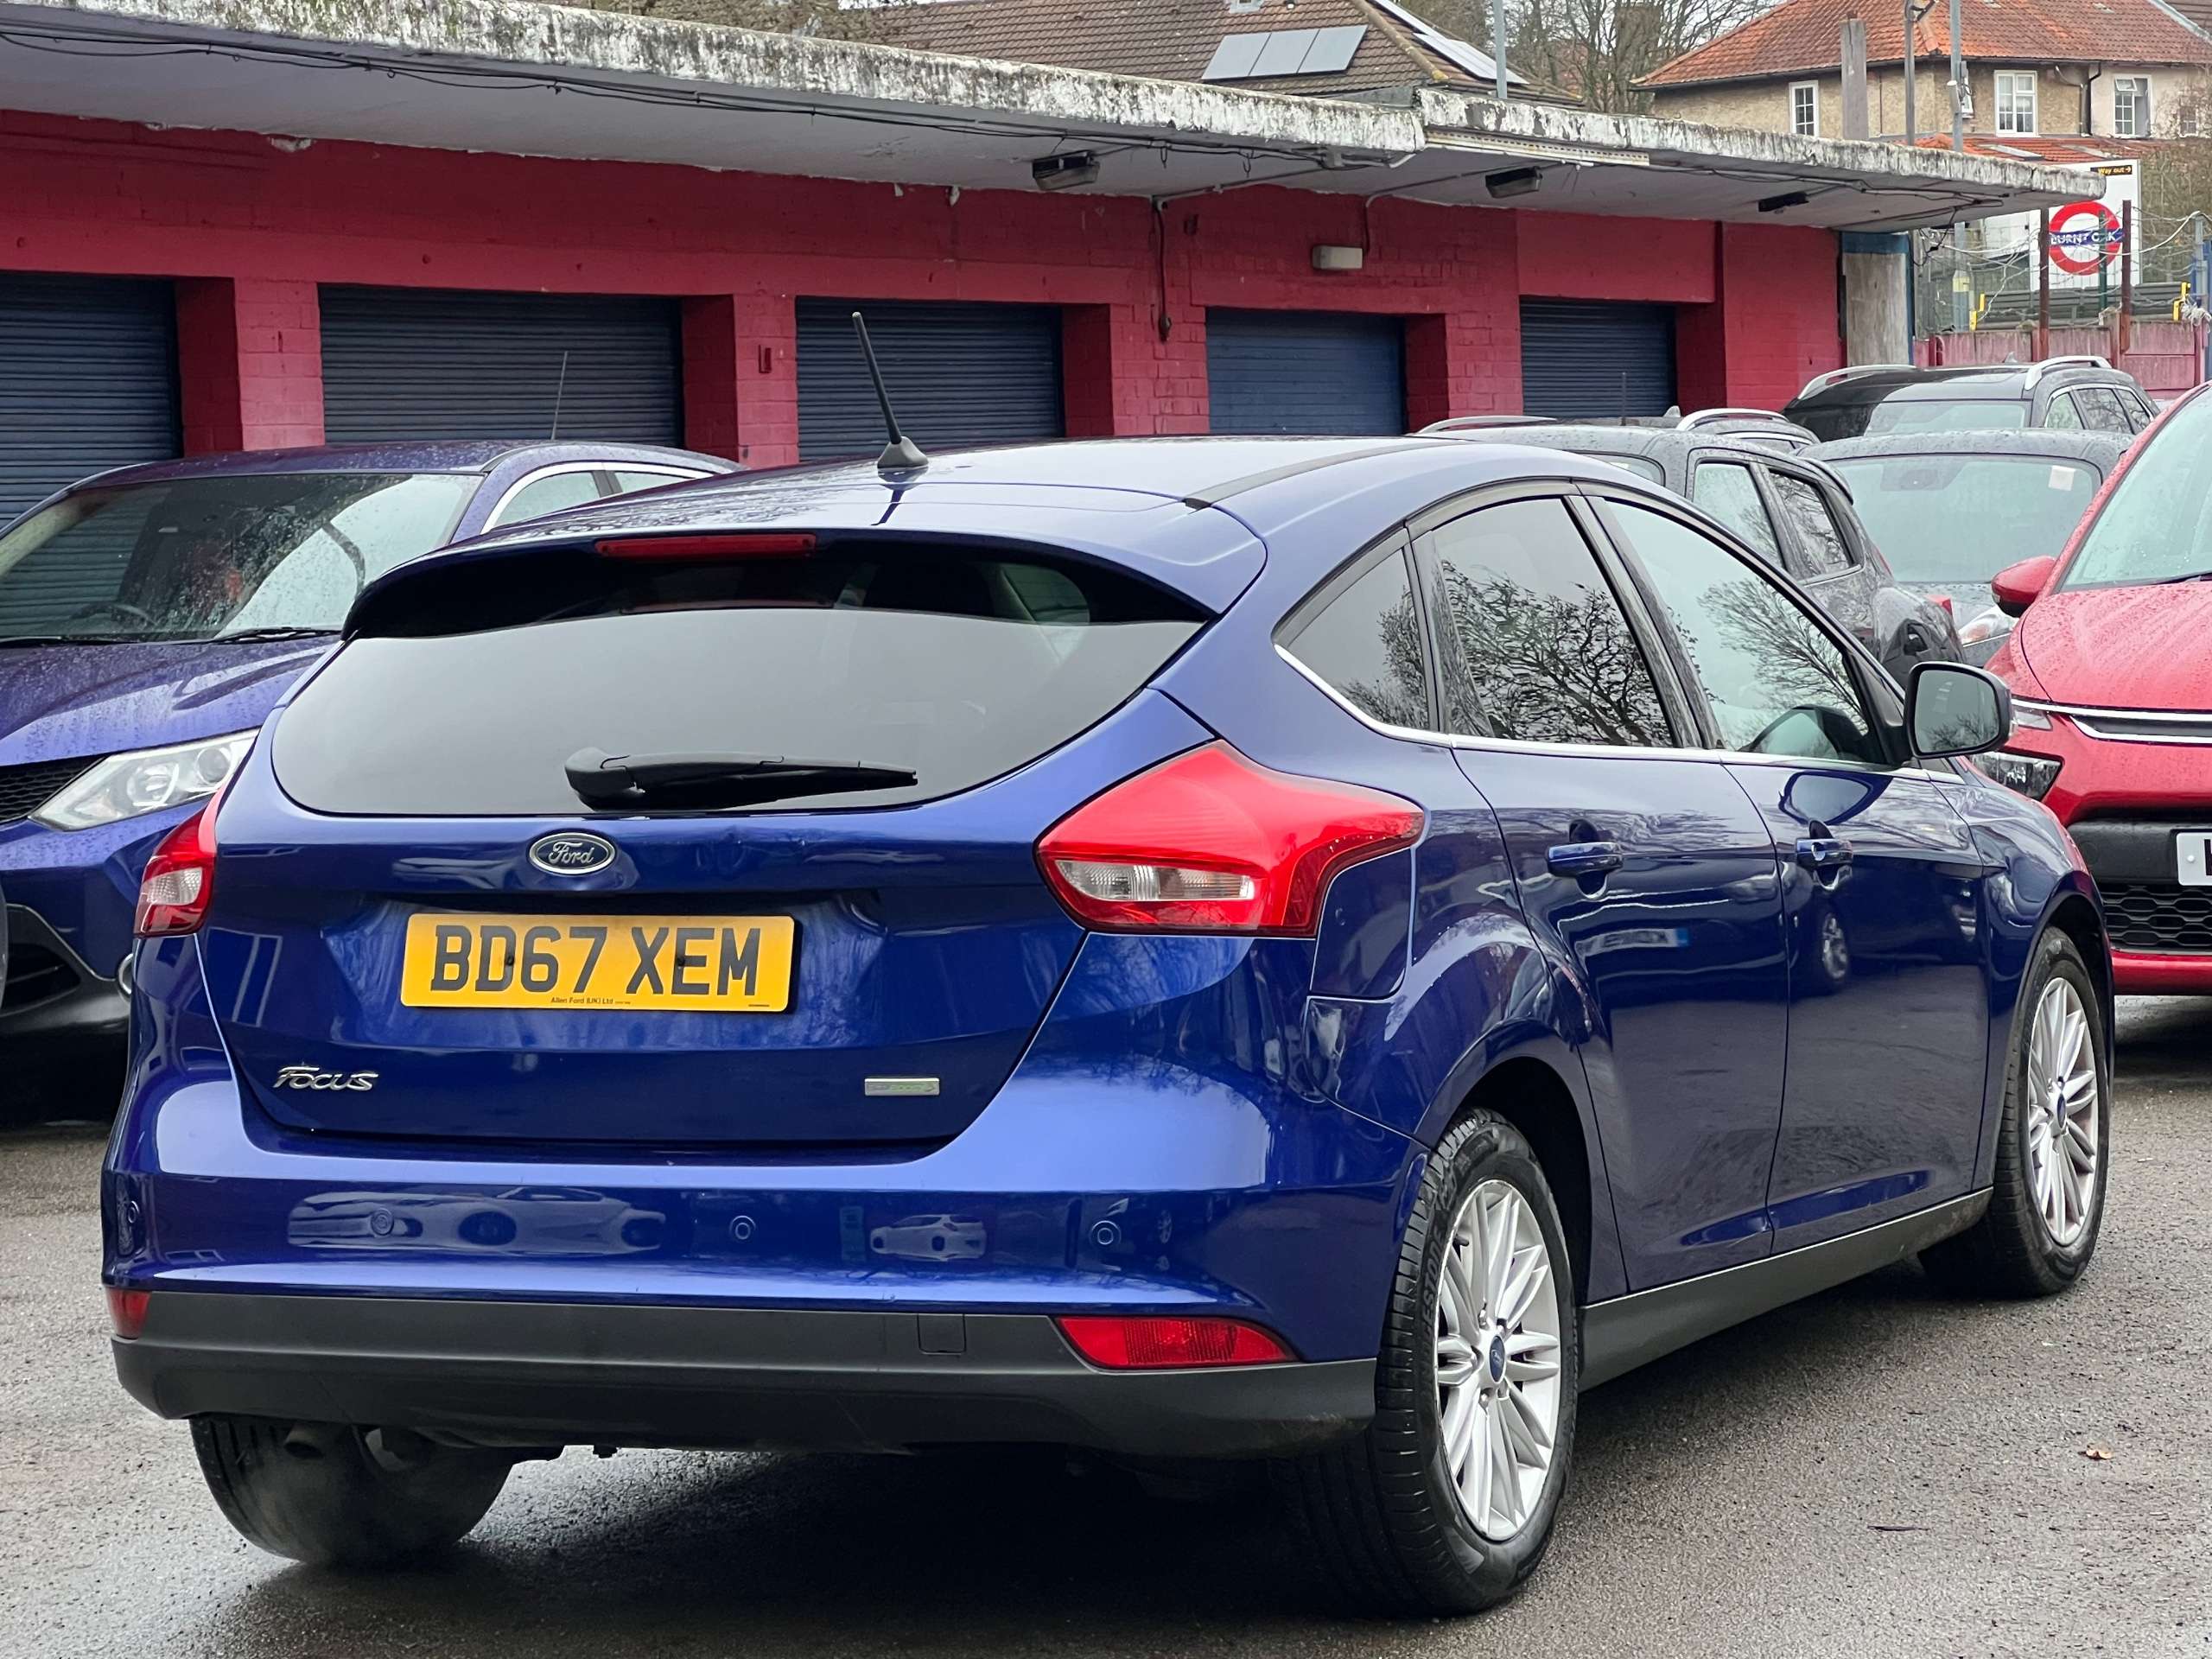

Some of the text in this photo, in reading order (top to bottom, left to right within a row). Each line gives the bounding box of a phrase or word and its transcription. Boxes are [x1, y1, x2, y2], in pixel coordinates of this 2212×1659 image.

[2091, 232, 2116, 242] OK
[548, 842, 594, 864] Ford
[430, 925, 761, 996] BD67 XEM
